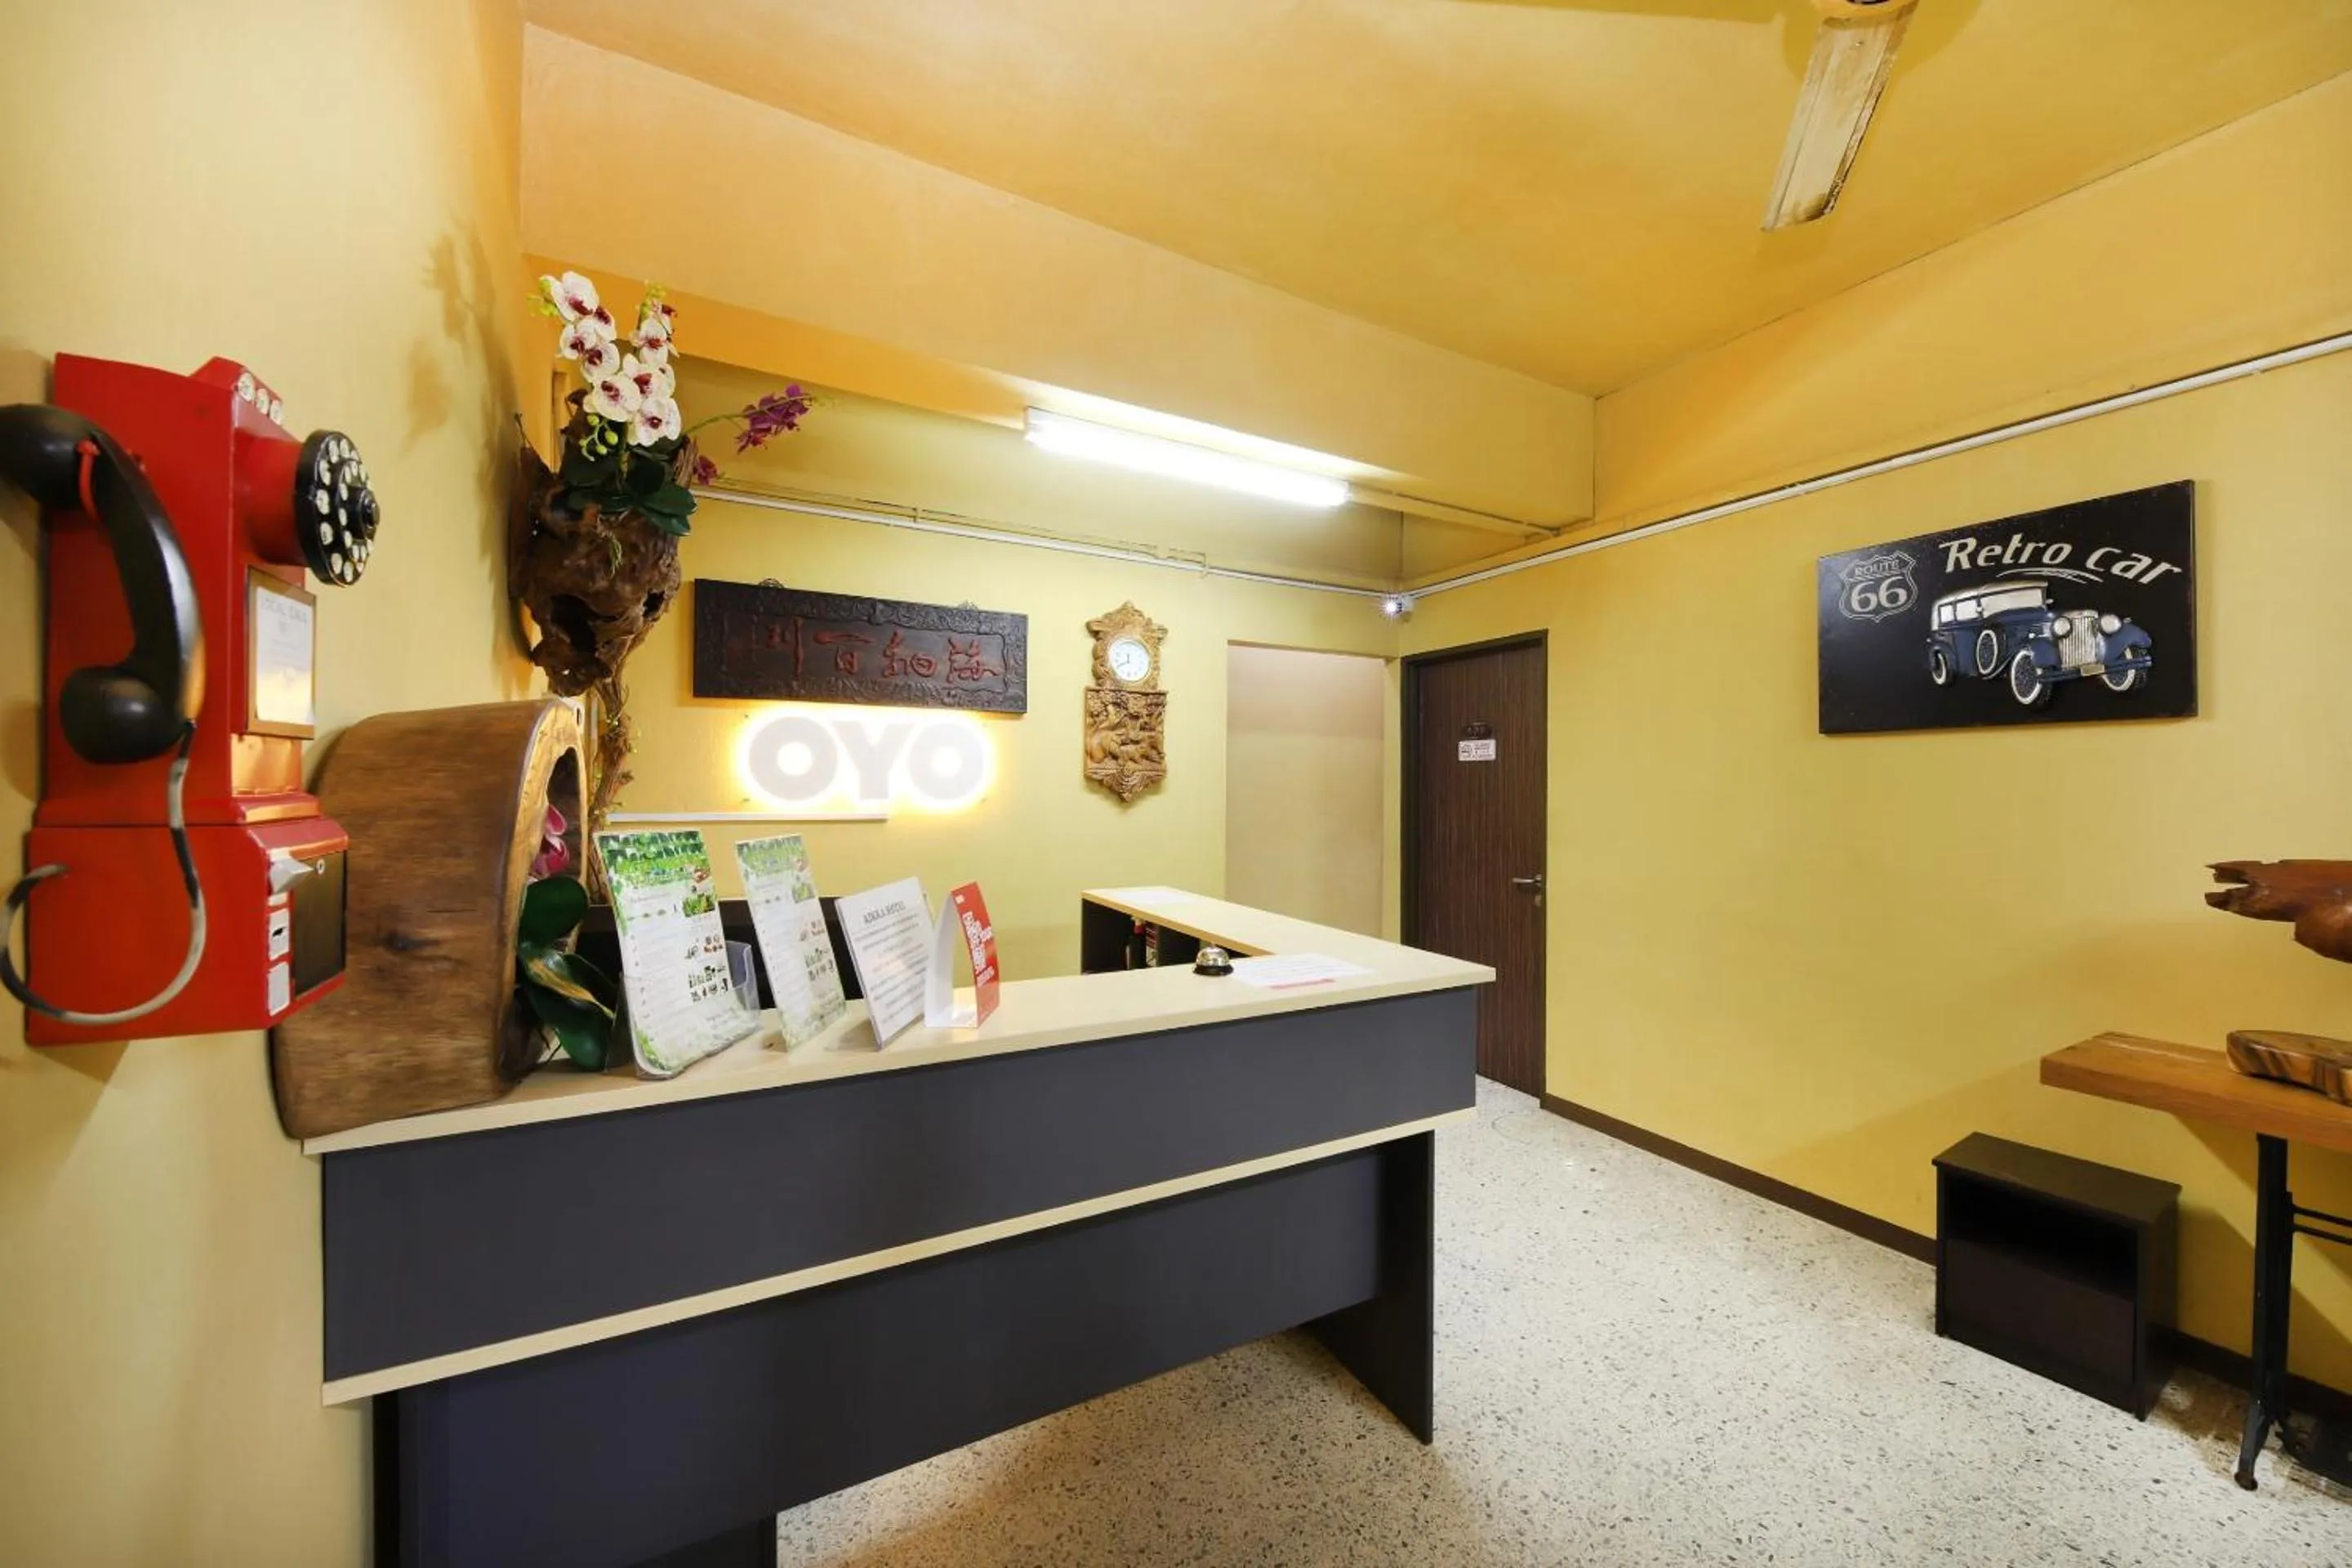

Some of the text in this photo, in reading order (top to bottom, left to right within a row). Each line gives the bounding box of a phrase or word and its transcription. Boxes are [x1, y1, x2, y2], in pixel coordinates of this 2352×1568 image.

[1855, 560, 1900, 575] ROUTE
[1939, 532, 2074, 573] Retro
[1851, 576, 1908, 612] 66
[748, 715, 985, 804] OYO
